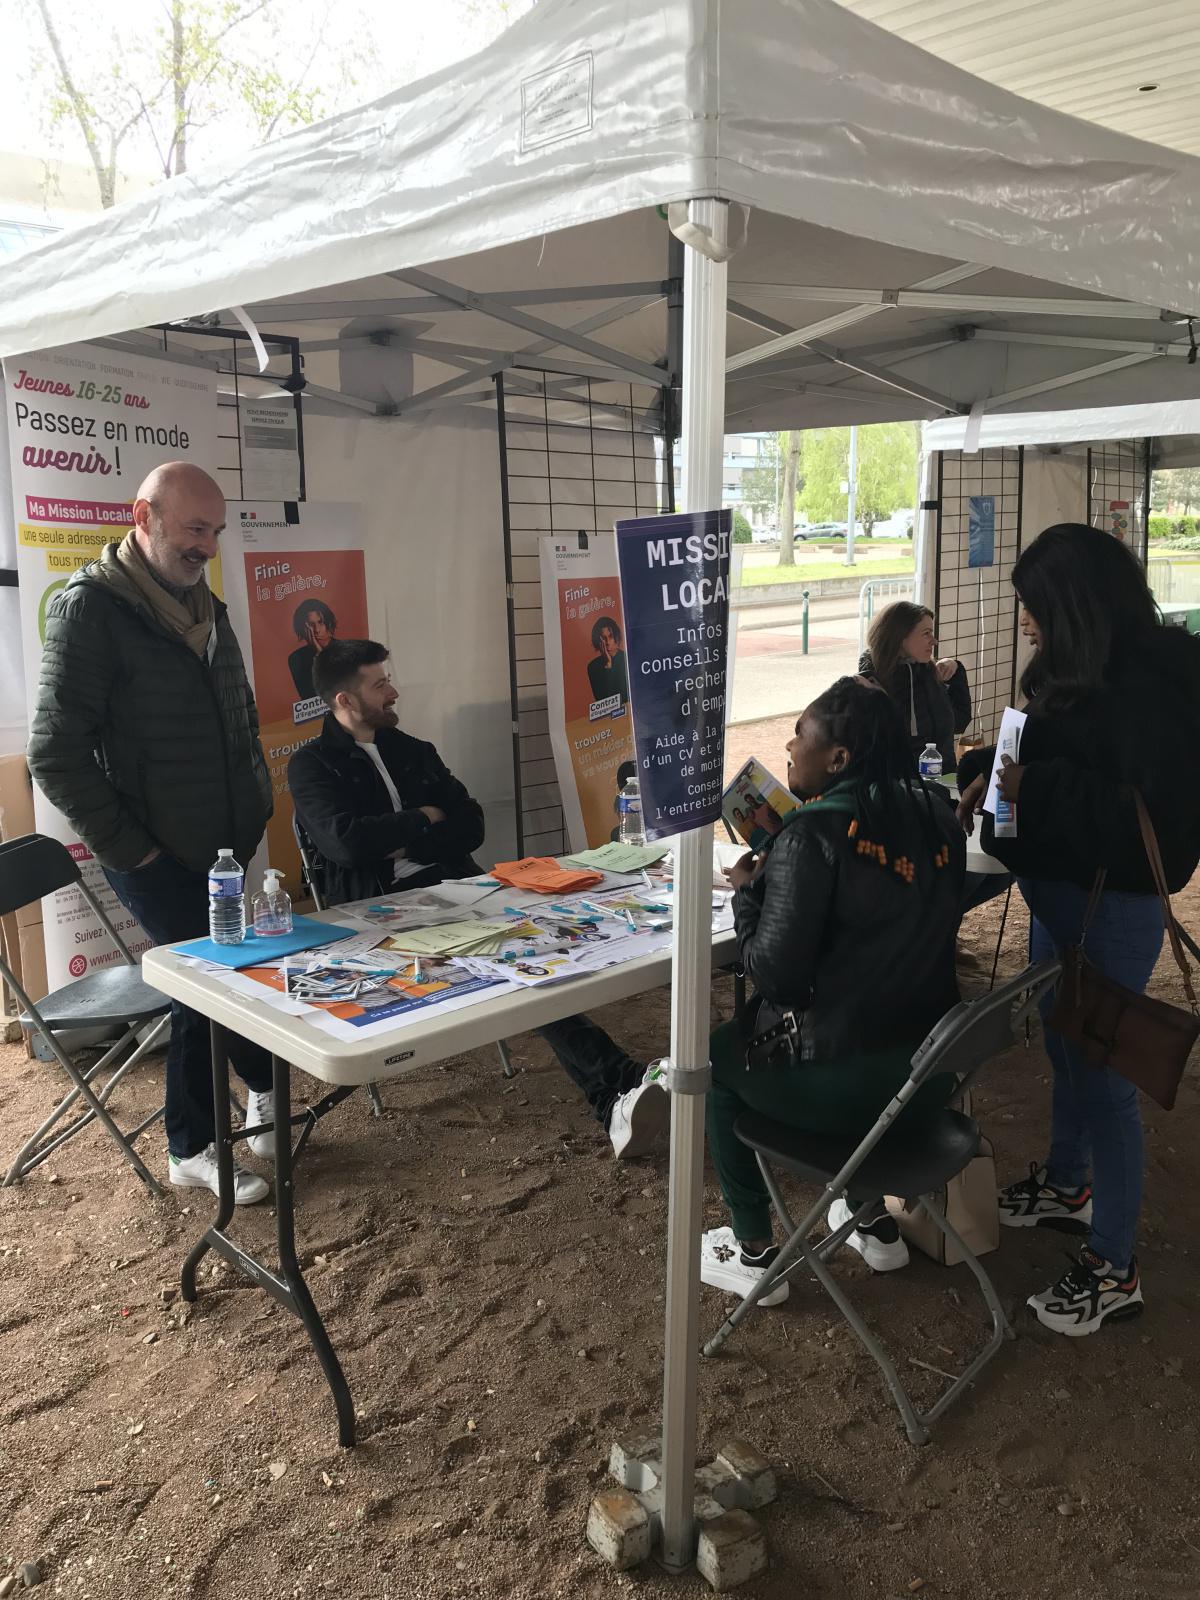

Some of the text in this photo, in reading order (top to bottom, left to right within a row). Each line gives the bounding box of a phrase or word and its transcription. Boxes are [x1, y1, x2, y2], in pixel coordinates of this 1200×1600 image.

[13, 370, 150, 409] Jeunes 16-25 ans
[15, 402, 190, 449] Passez en mode
[29, 501, 134, 522] Ma Mission Locale
[39, 530, 65, 544] seule
[67, 532, 107, 546] adresse
[49, 554, 71, 567] tous
[646, 532, 731, 569] MISSI
[254, 560, 291, 581] Finie
[256, 585, 271, 601] la
[564, 585, 590, 603] Finie
[676, 623, 722, 644] Infos
[641, 647, 721, 675] conseils
[590, 696, 619, 712] Contrat
[574, 728, 612, 750] trouvez
[655, 733, 685, 750] Aide
[692, 730, 700, 742] à
[705, 726, 718, 740] la
[679, 747, 694, 761] CV
[700, 744, 712, 757] et
[680, 765, 695, 777] de
[75, 928, 103, 944] Suivez
